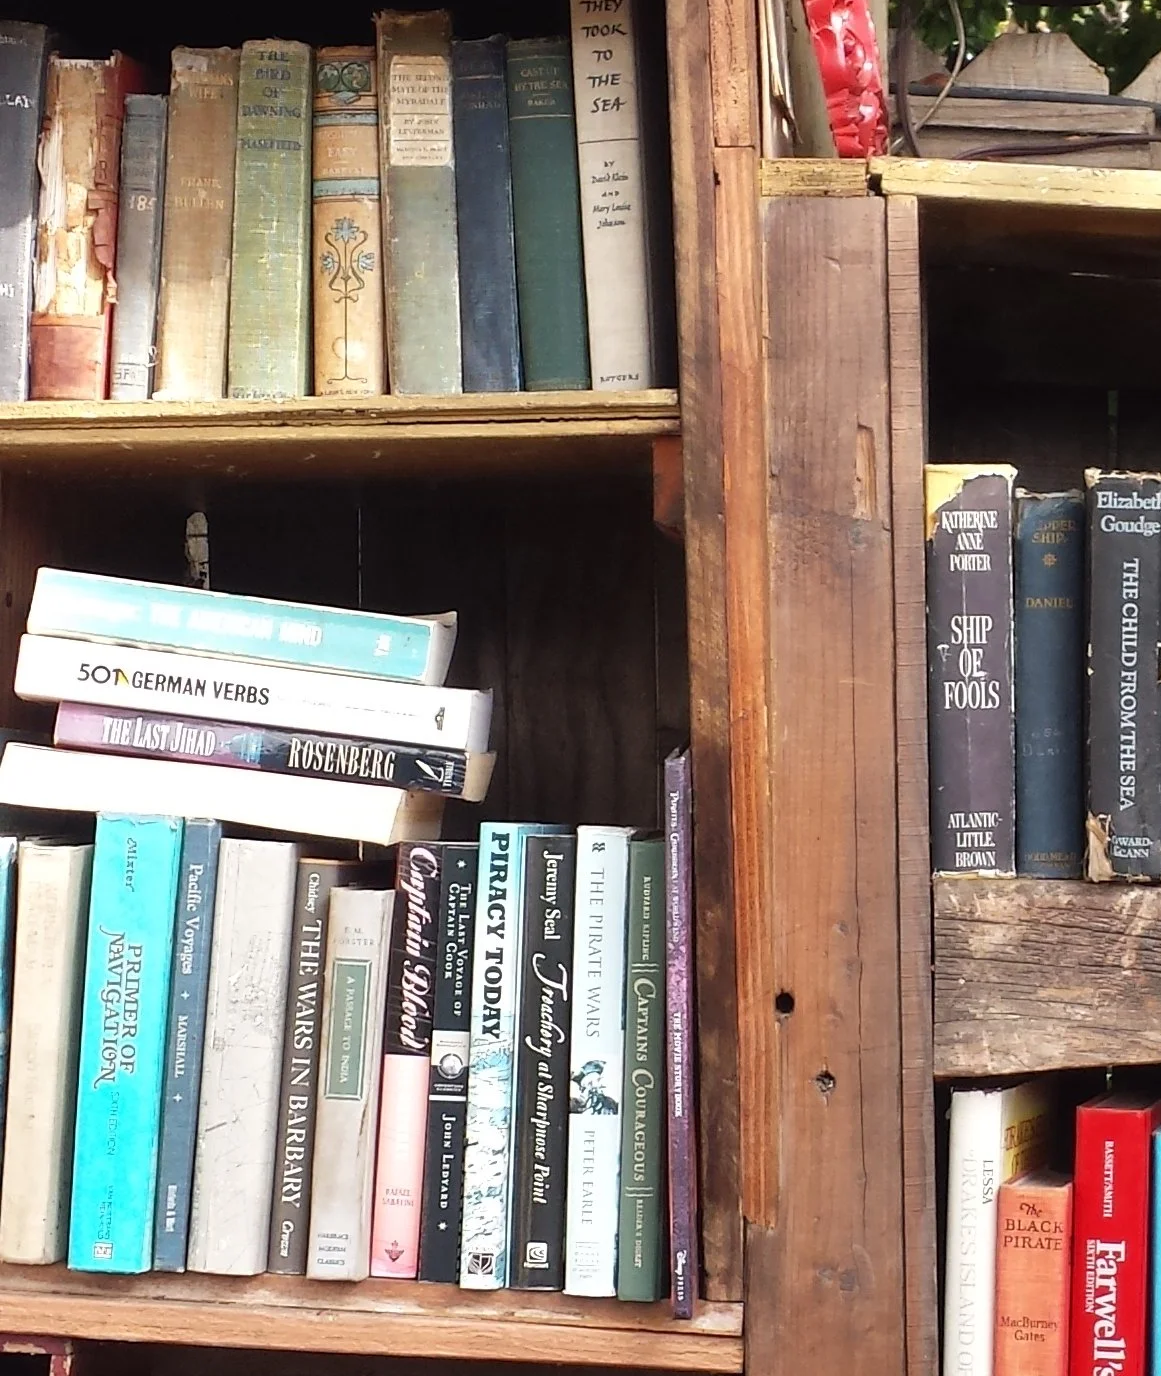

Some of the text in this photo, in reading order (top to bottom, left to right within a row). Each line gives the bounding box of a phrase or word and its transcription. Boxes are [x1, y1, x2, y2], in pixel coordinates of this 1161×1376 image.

[580, 0, 624, 13] THEY
[582, 24, 627, 38] TOOK
[593, 50, 613, 62] TO
[587, 74, 621, 87] THE
[590, 98, 626, 112] SEA
[940, 510, 998, 530] KATHERINE
[1100, 515, 1161, 535] Goudge
[955, 534, 985, 550] ANNE
[949, 554, 993, 572] PORTER
[951, 615, 993, 645] SHIP
[958, 648, 986, 679] OF
[132, 671, 207, 697] GERMAN
[213, 681, 270, 705] VERBS
[943, 679, 1000, 710] FOOLS
[1119, 558, 1140, 811] THE CHILD FROM THE SEA
[102, 716, 216, 756] THE LAST JIHAD
[288, 739, 395, 780] ROSENBERG
[955, 851, 996, 867] BROWN
[542, 850, 566, 941] Jeremy Seal
[176, 863, 205, 975] Pacific Voyages
[399, 847, 440, 1052] Captain Blood
[481, 832, 510, 1039] PIRACY TODAY
[585, 867, 608, 1038] THE PIRATE WARS
[93, 926, 126, 1091] NAVIGATION
[120, 944, 143, 1074] PRIMER OF
[281, 920, 322, 1208] THE WARS IN BARBARY
[524, 953, 568, 1205] Treachery at Sharpnose Point
[628, 977, 656, 1183] CAPTAINS COURAGEOUS
[439, 1113, 456, 1210] JOHN LEDYARD
[1004, 1219, 1064, 1231] BLACK
[1003, 1235, 1063, 1251] PIRATE
